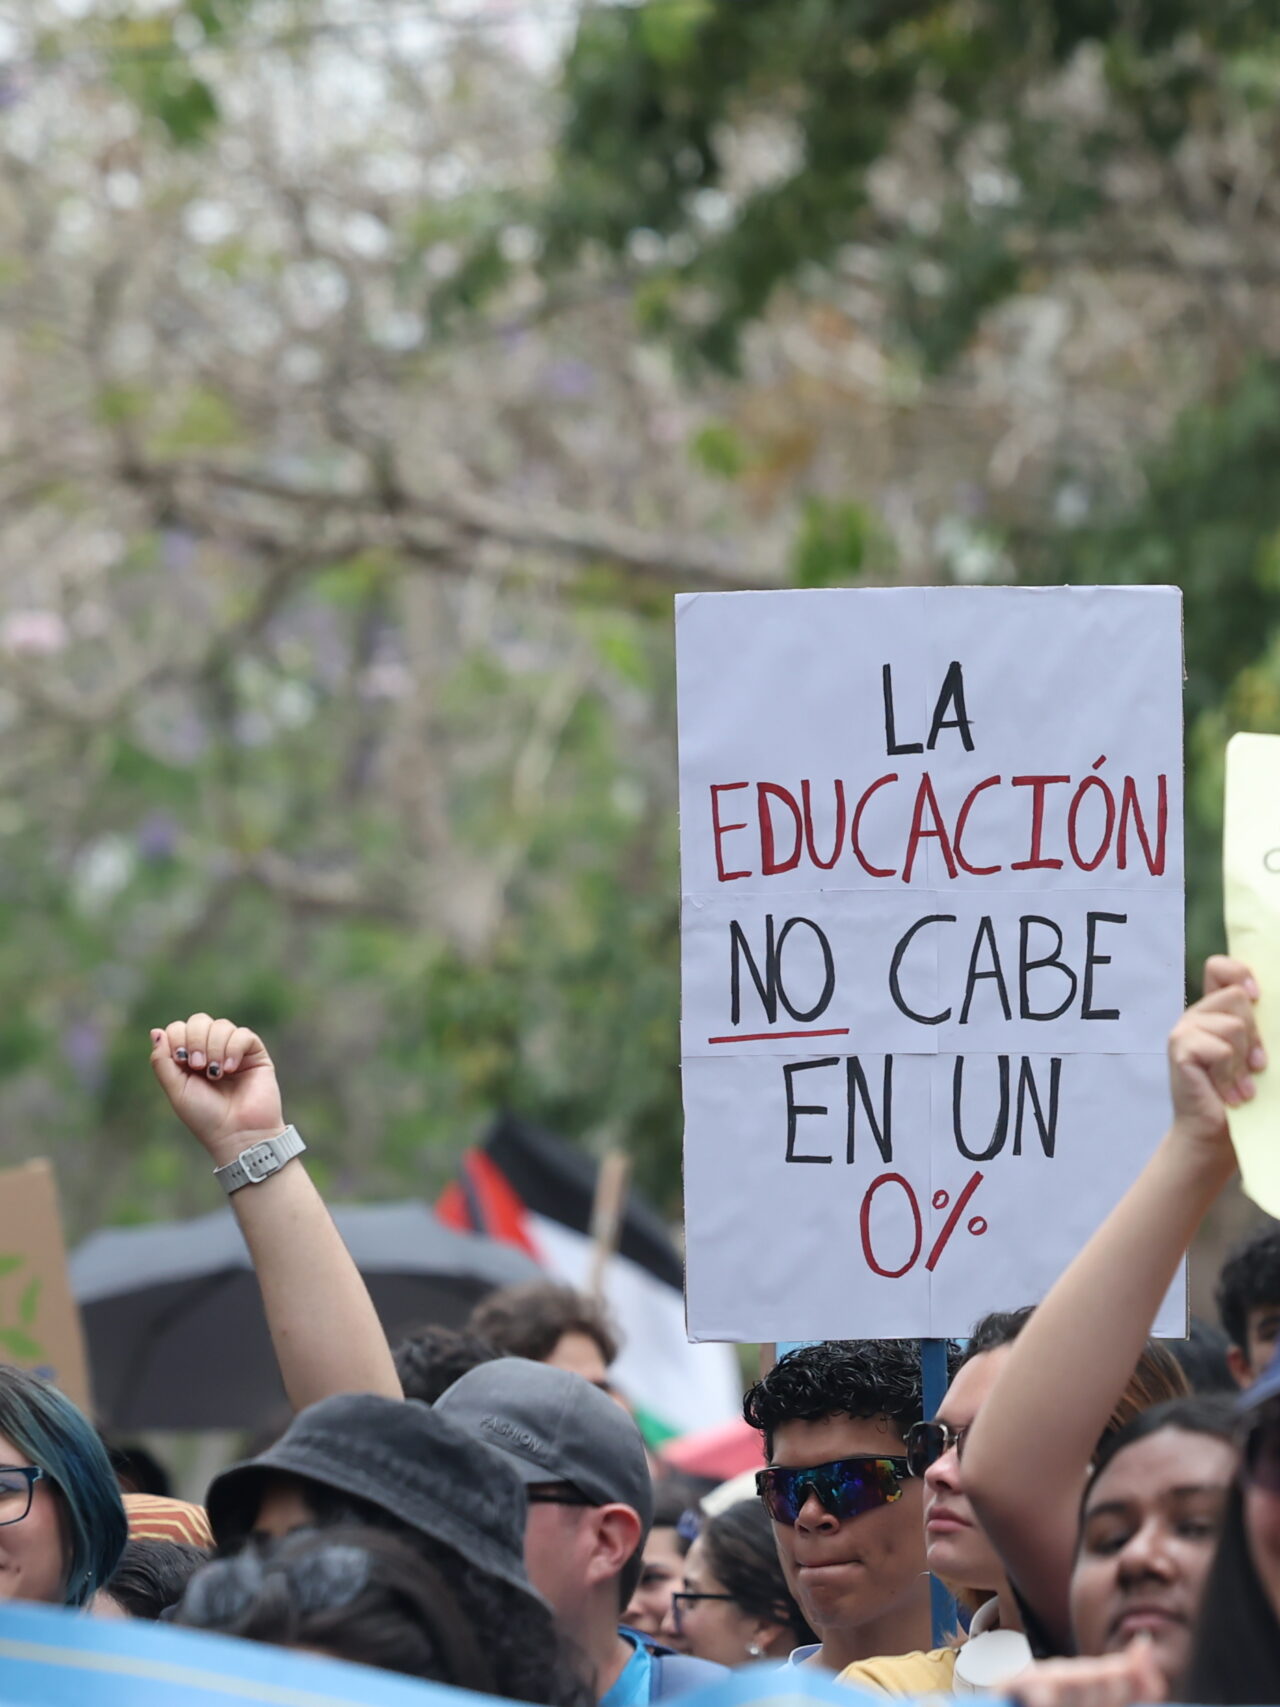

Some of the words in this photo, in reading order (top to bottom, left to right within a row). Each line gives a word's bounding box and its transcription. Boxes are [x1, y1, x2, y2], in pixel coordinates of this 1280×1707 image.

[882, 660, 976, 756] LA
[709, 754, 1169, 884] EDUCACIÓN
[729, 914, 836, 1025] NO
[888, 912, 1128, 1025] CABE
[783, 1053, 894, 1165] EN
[952, 1054, 1063, 1163] UN
[859, 1170, 989, 1279] 0%
